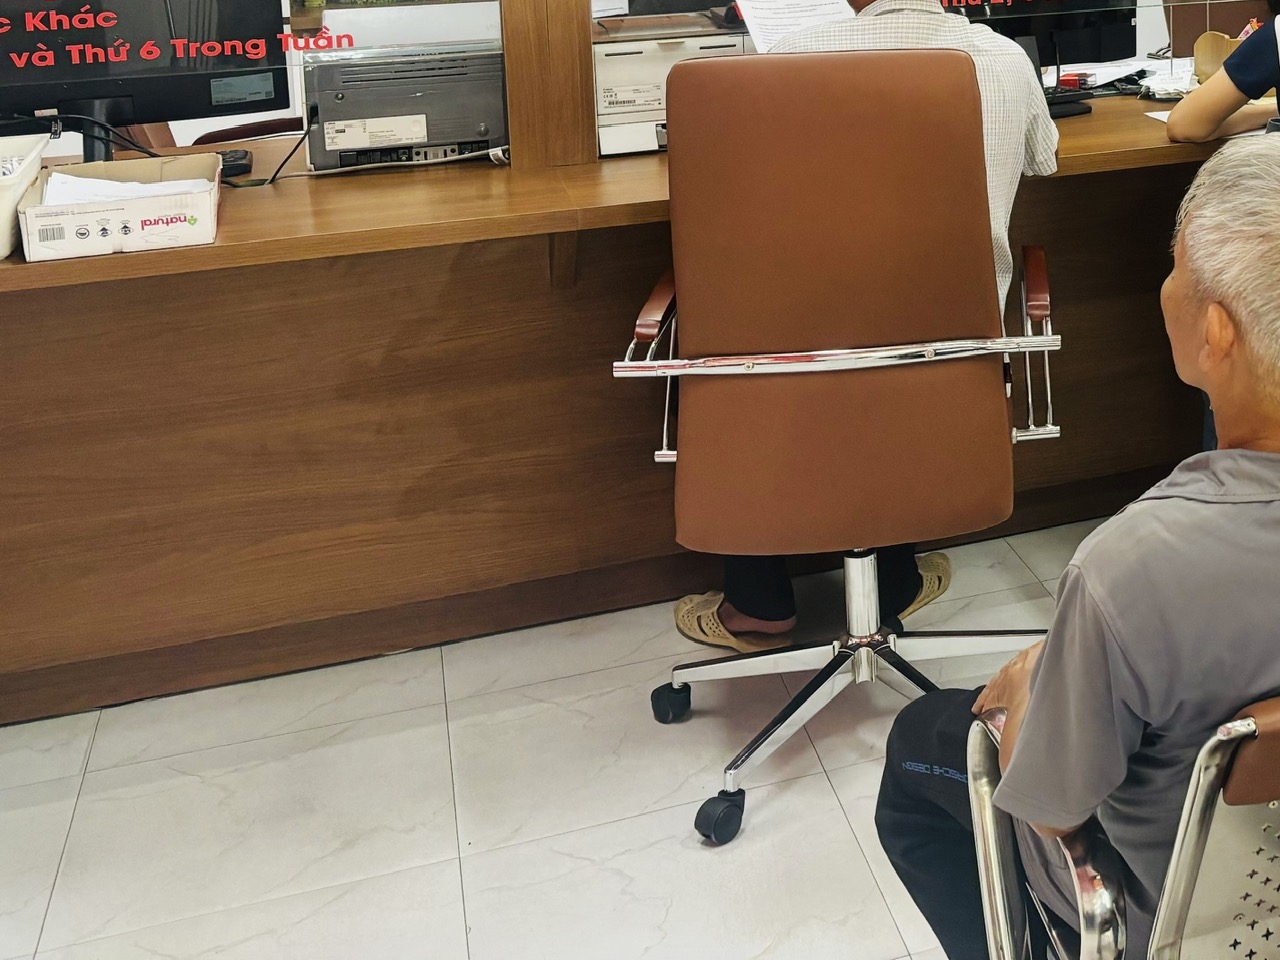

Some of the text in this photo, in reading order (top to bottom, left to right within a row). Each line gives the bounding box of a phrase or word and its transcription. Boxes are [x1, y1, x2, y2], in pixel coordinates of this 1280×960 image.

[24, 5, 118, 32] Khác
[9, 26, 353, 68] và Thứ 6 Trong Tuần
[141, 215, 187, 231] natural
